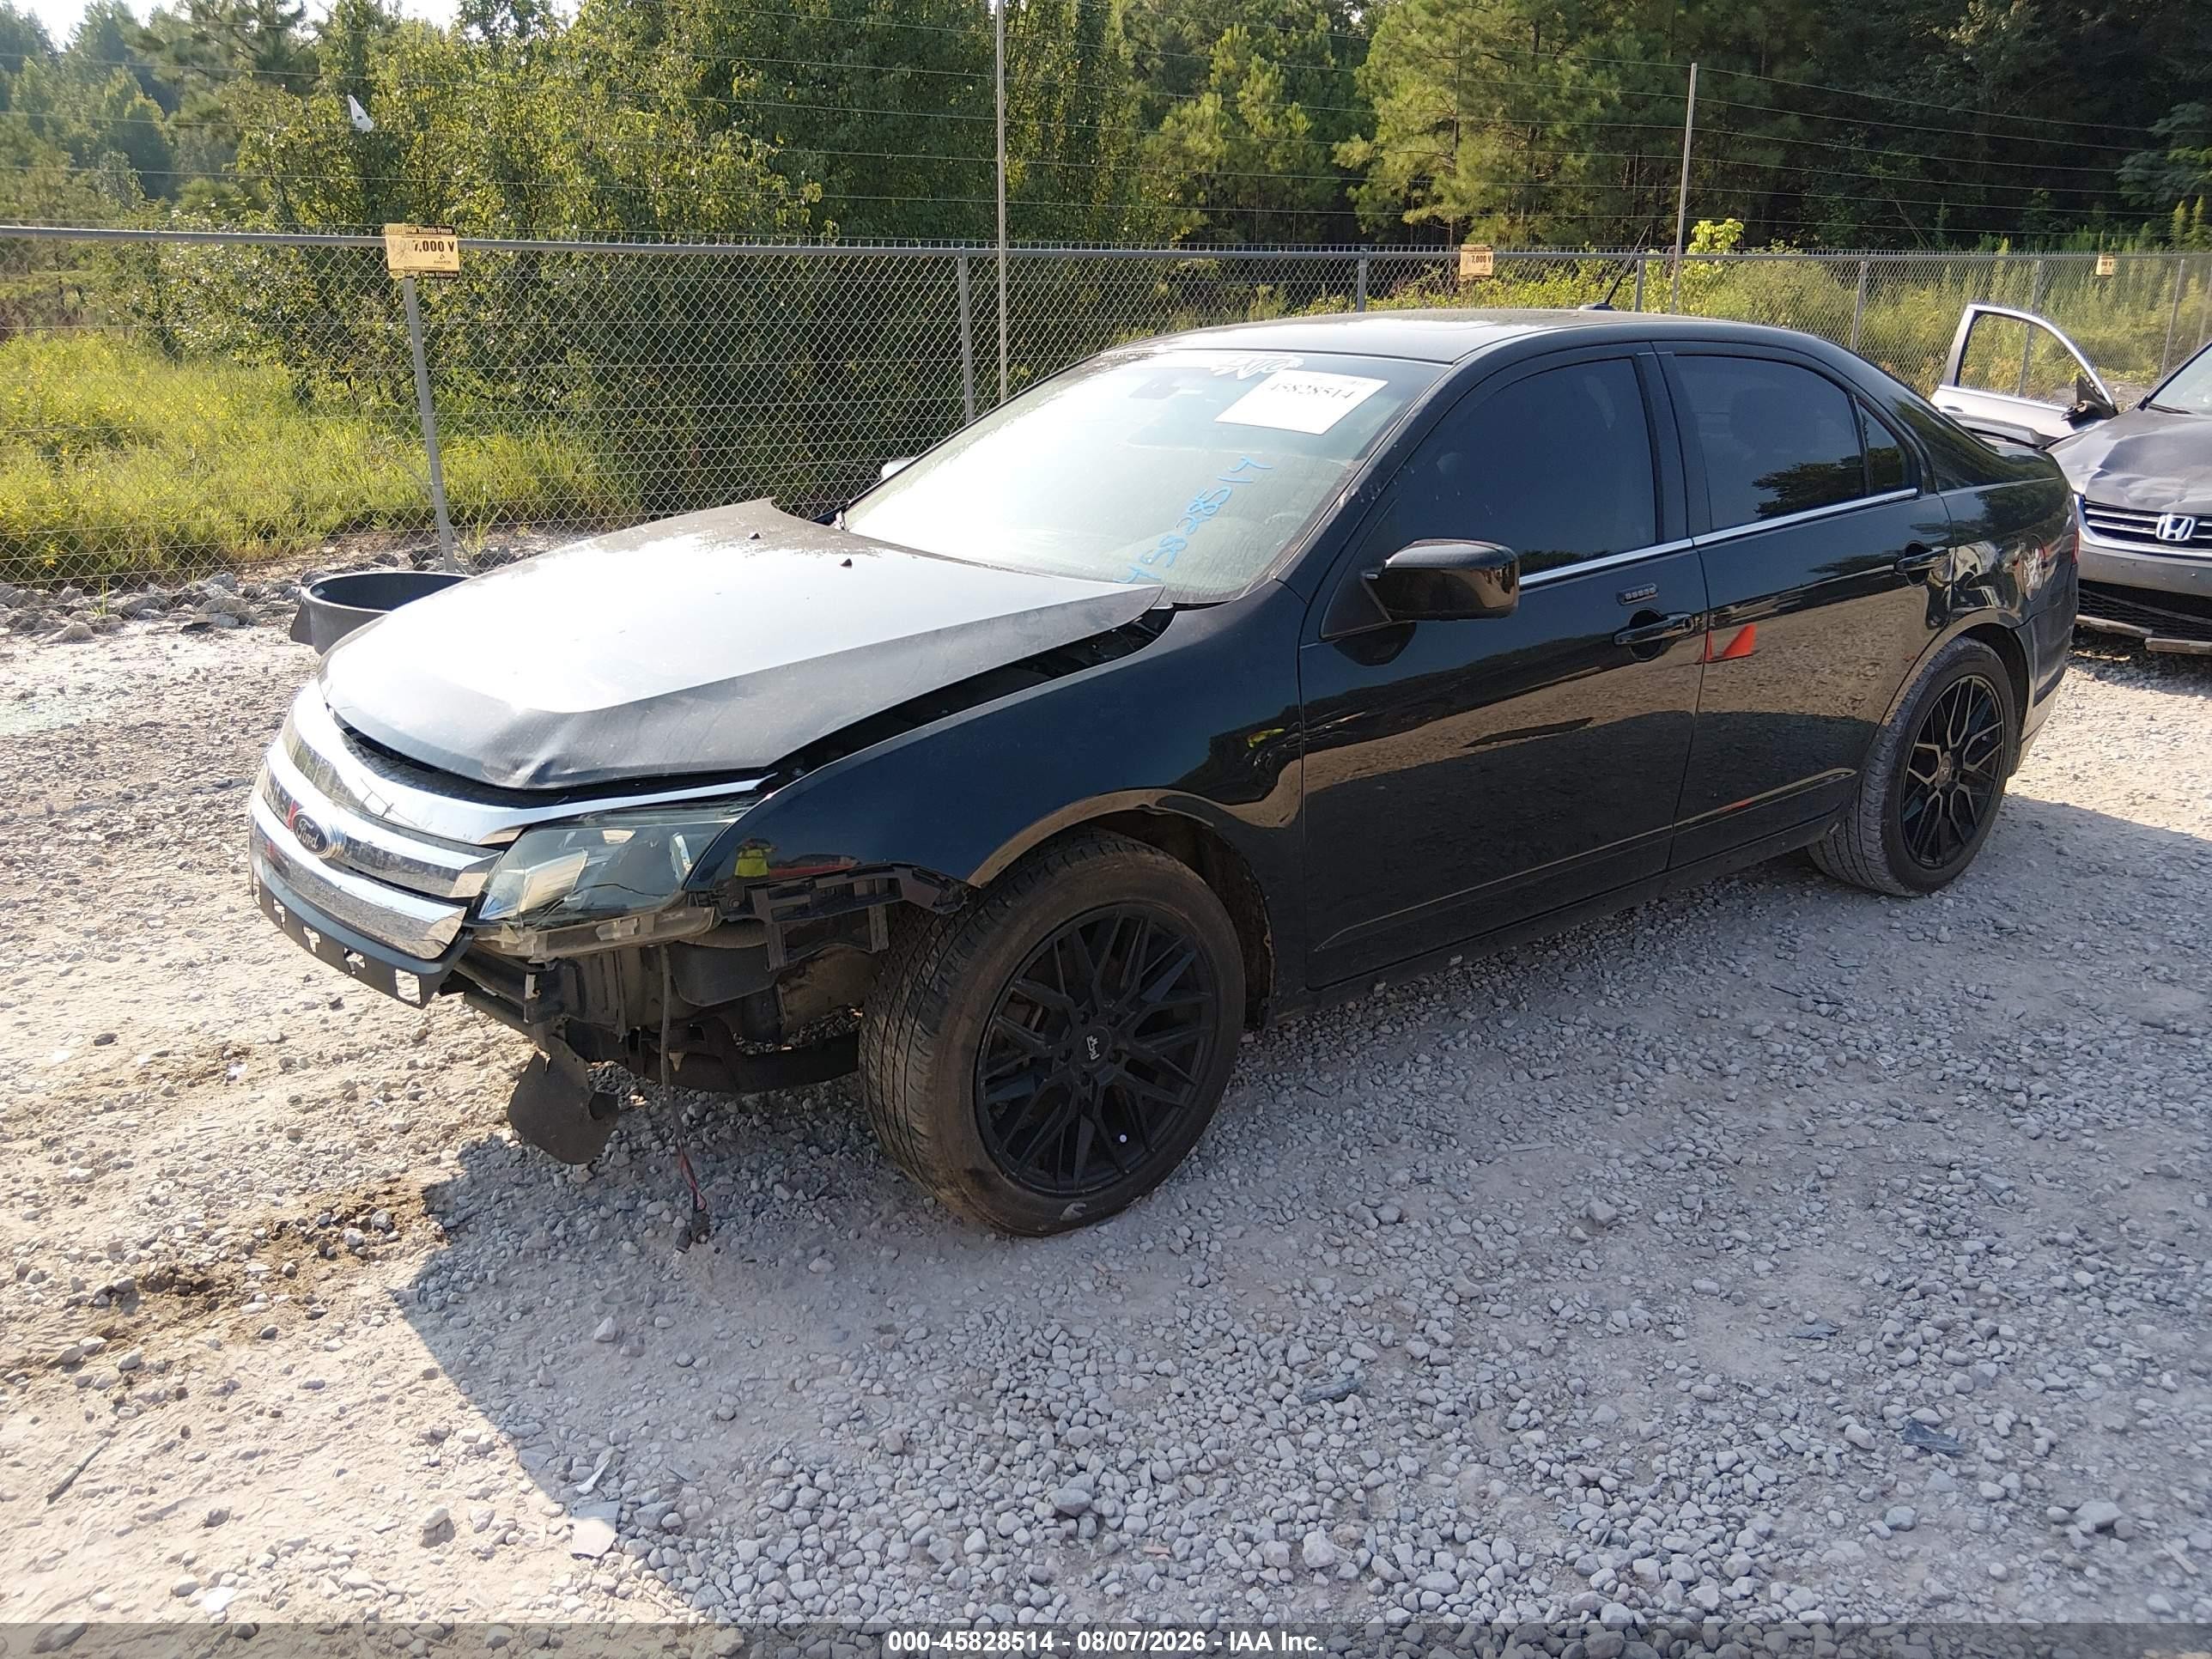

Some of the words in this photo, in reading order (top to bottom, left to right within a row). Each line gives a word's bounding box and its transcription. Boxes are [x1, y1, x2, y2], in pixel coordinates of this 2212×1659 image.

[412, 240, 444, 252] 7,000
[447, 240, 454, 252] V
[295, 817, 319, 849] Ford
